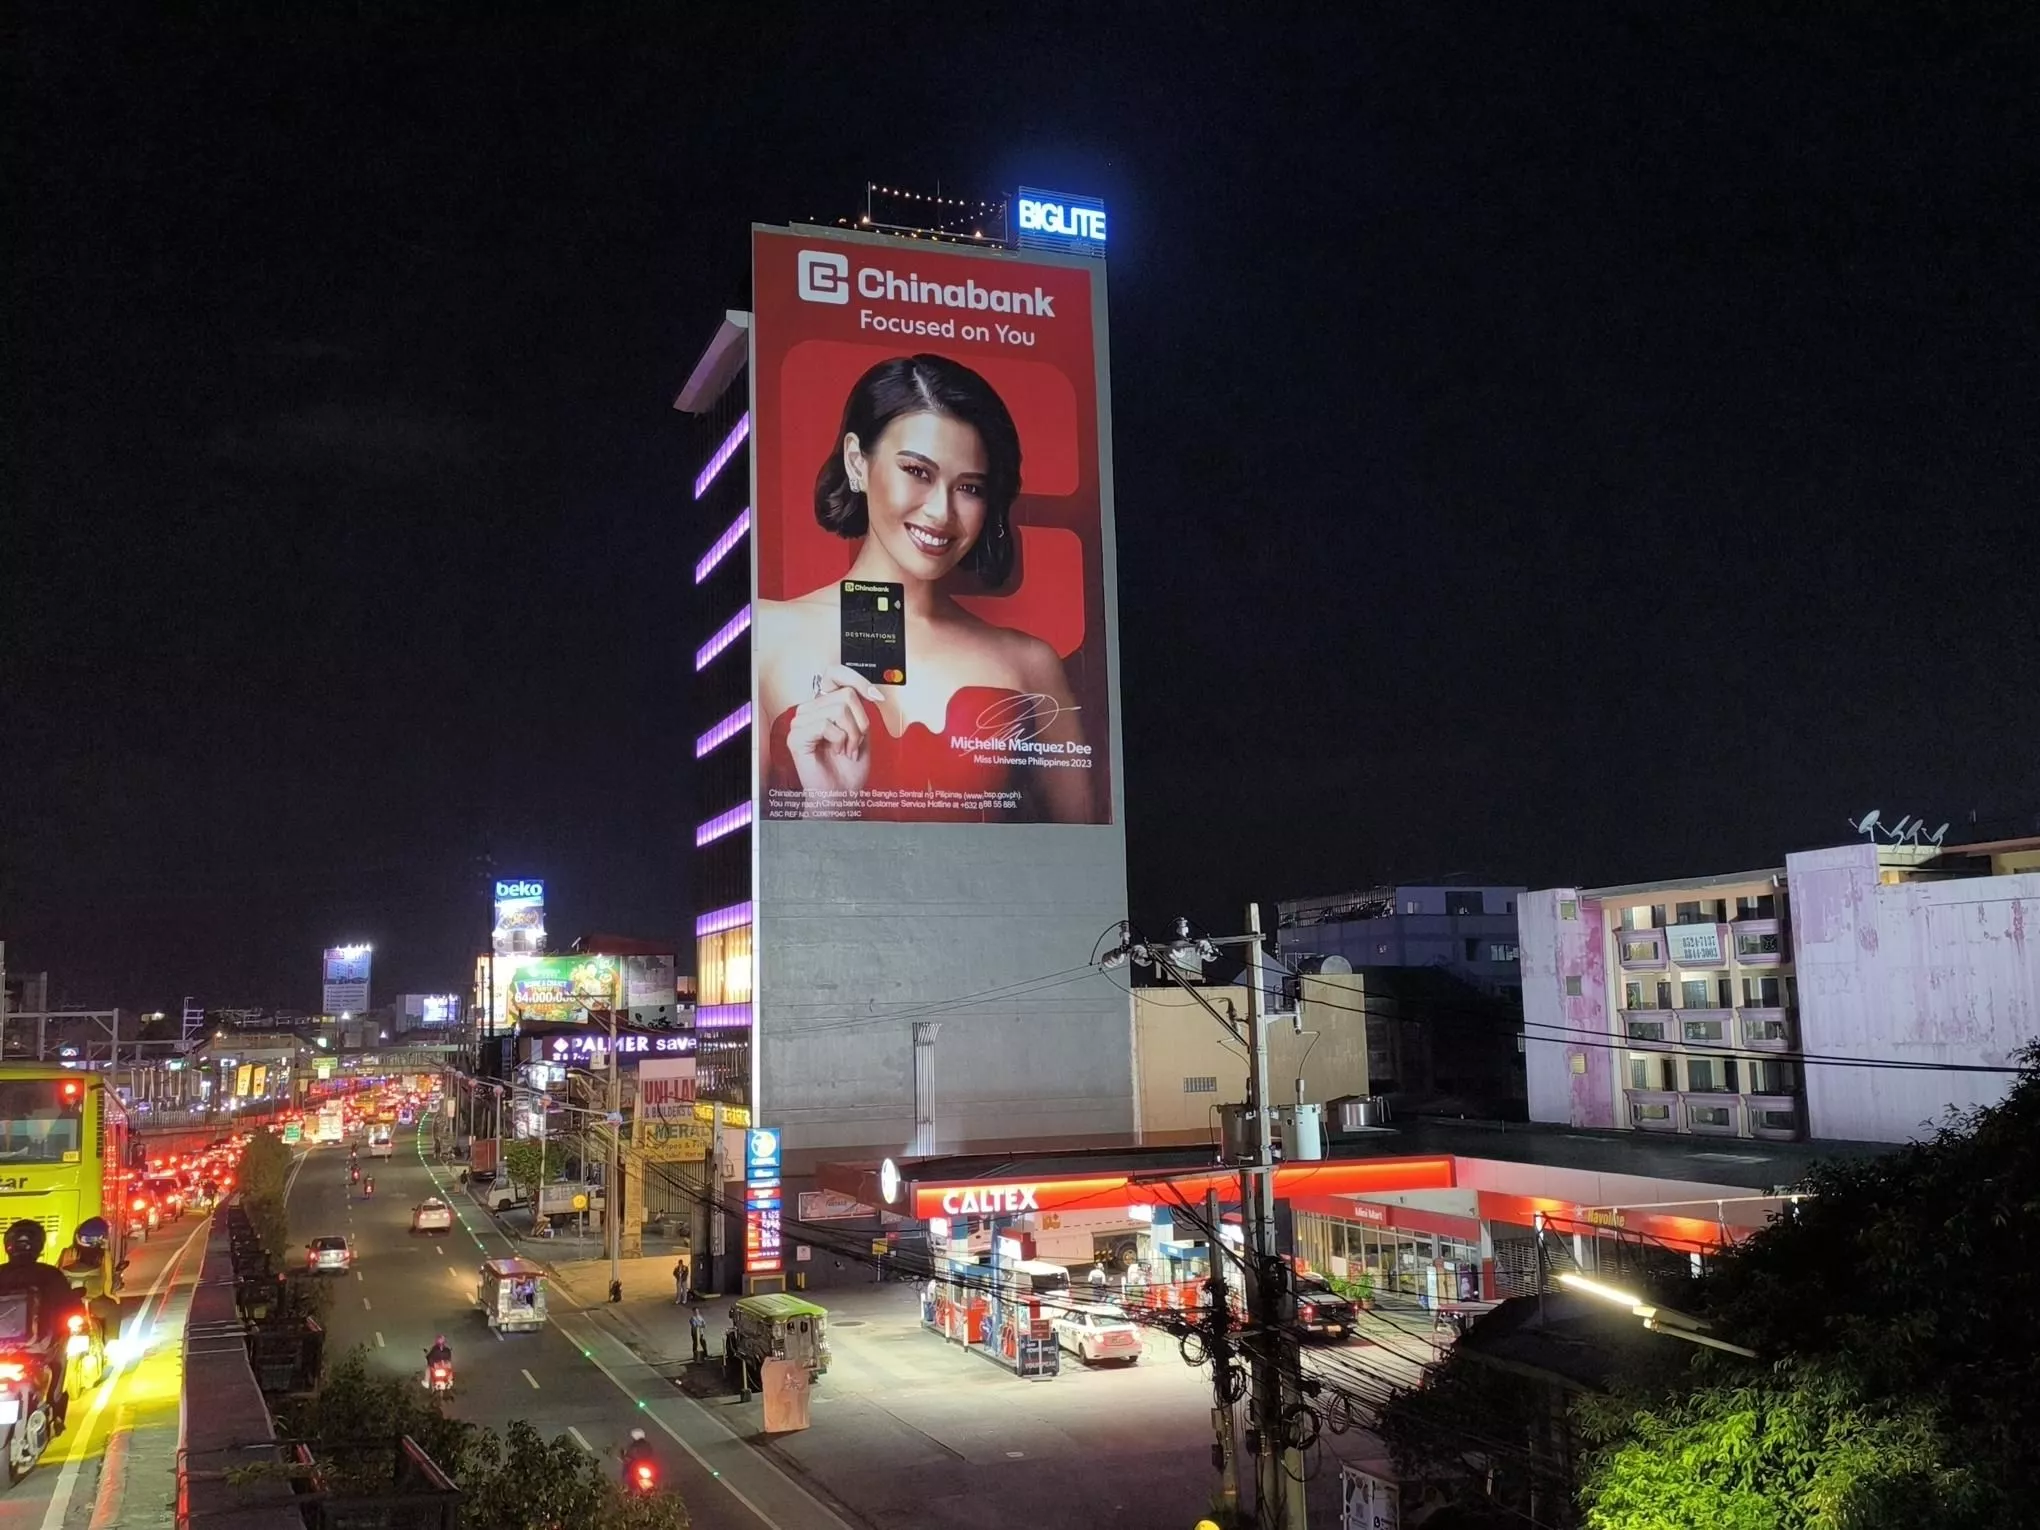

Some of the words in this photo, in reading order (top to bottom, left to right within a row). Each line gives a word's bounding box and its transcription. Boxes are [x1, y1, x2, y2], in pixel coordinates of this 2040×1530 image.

[1019, 199, 1106, 240] BIGLITE
[857, 267, 1056, 318] Chinabank
[859, 309, 955, 339] Focused
[961, 326, 990, 342] on
[994, 323, 1035, 346] You
[854, 584, 889, 592] Chinabank
[845, 631, 896, 639] DESTINATIONS
[951, 736, 1006, 751] Michelle
[1009, 738, 1065, 755] Marquez
[1066, 741, 1092, 754] Dee
[974, 755, 992, 764] Miss
[993, 756, 1027, 766] Universe
[1028, 757, 1070, 768] Philippines
[1071, 758, 1092, 768] 2023
[768, 789, 805, 798] Chinabank
[814, 790, 848, 799] regulated
[849, 790, 858, 799] by
[860, 789, 871, 798] the
[872, 789, 898, 799] Bangko
[899, 790, 923, 798] Sentral
[924, 791, 934, 800] ng
[935, 790, 962, 799] Pilipinas
[769, 799, 783, 807] You
[784, 800, 800, 809] may
[866, 800, 899, 808] Customer
[900, 800, 926, 808] Service
[927, 800, 952, 808] Hotline
[769, 810, 783, 818] ASC
[784, 810, 798, 818] REF
[496, 881, 543, 896] beko
[652, 1105, 685, 1117] BUILDERS
[943, 1187, 1039, 1214] CALTEX
[1354, 1207, 1367, 1218] Mini
[1368, 1209, 1384, 1221] Mart
